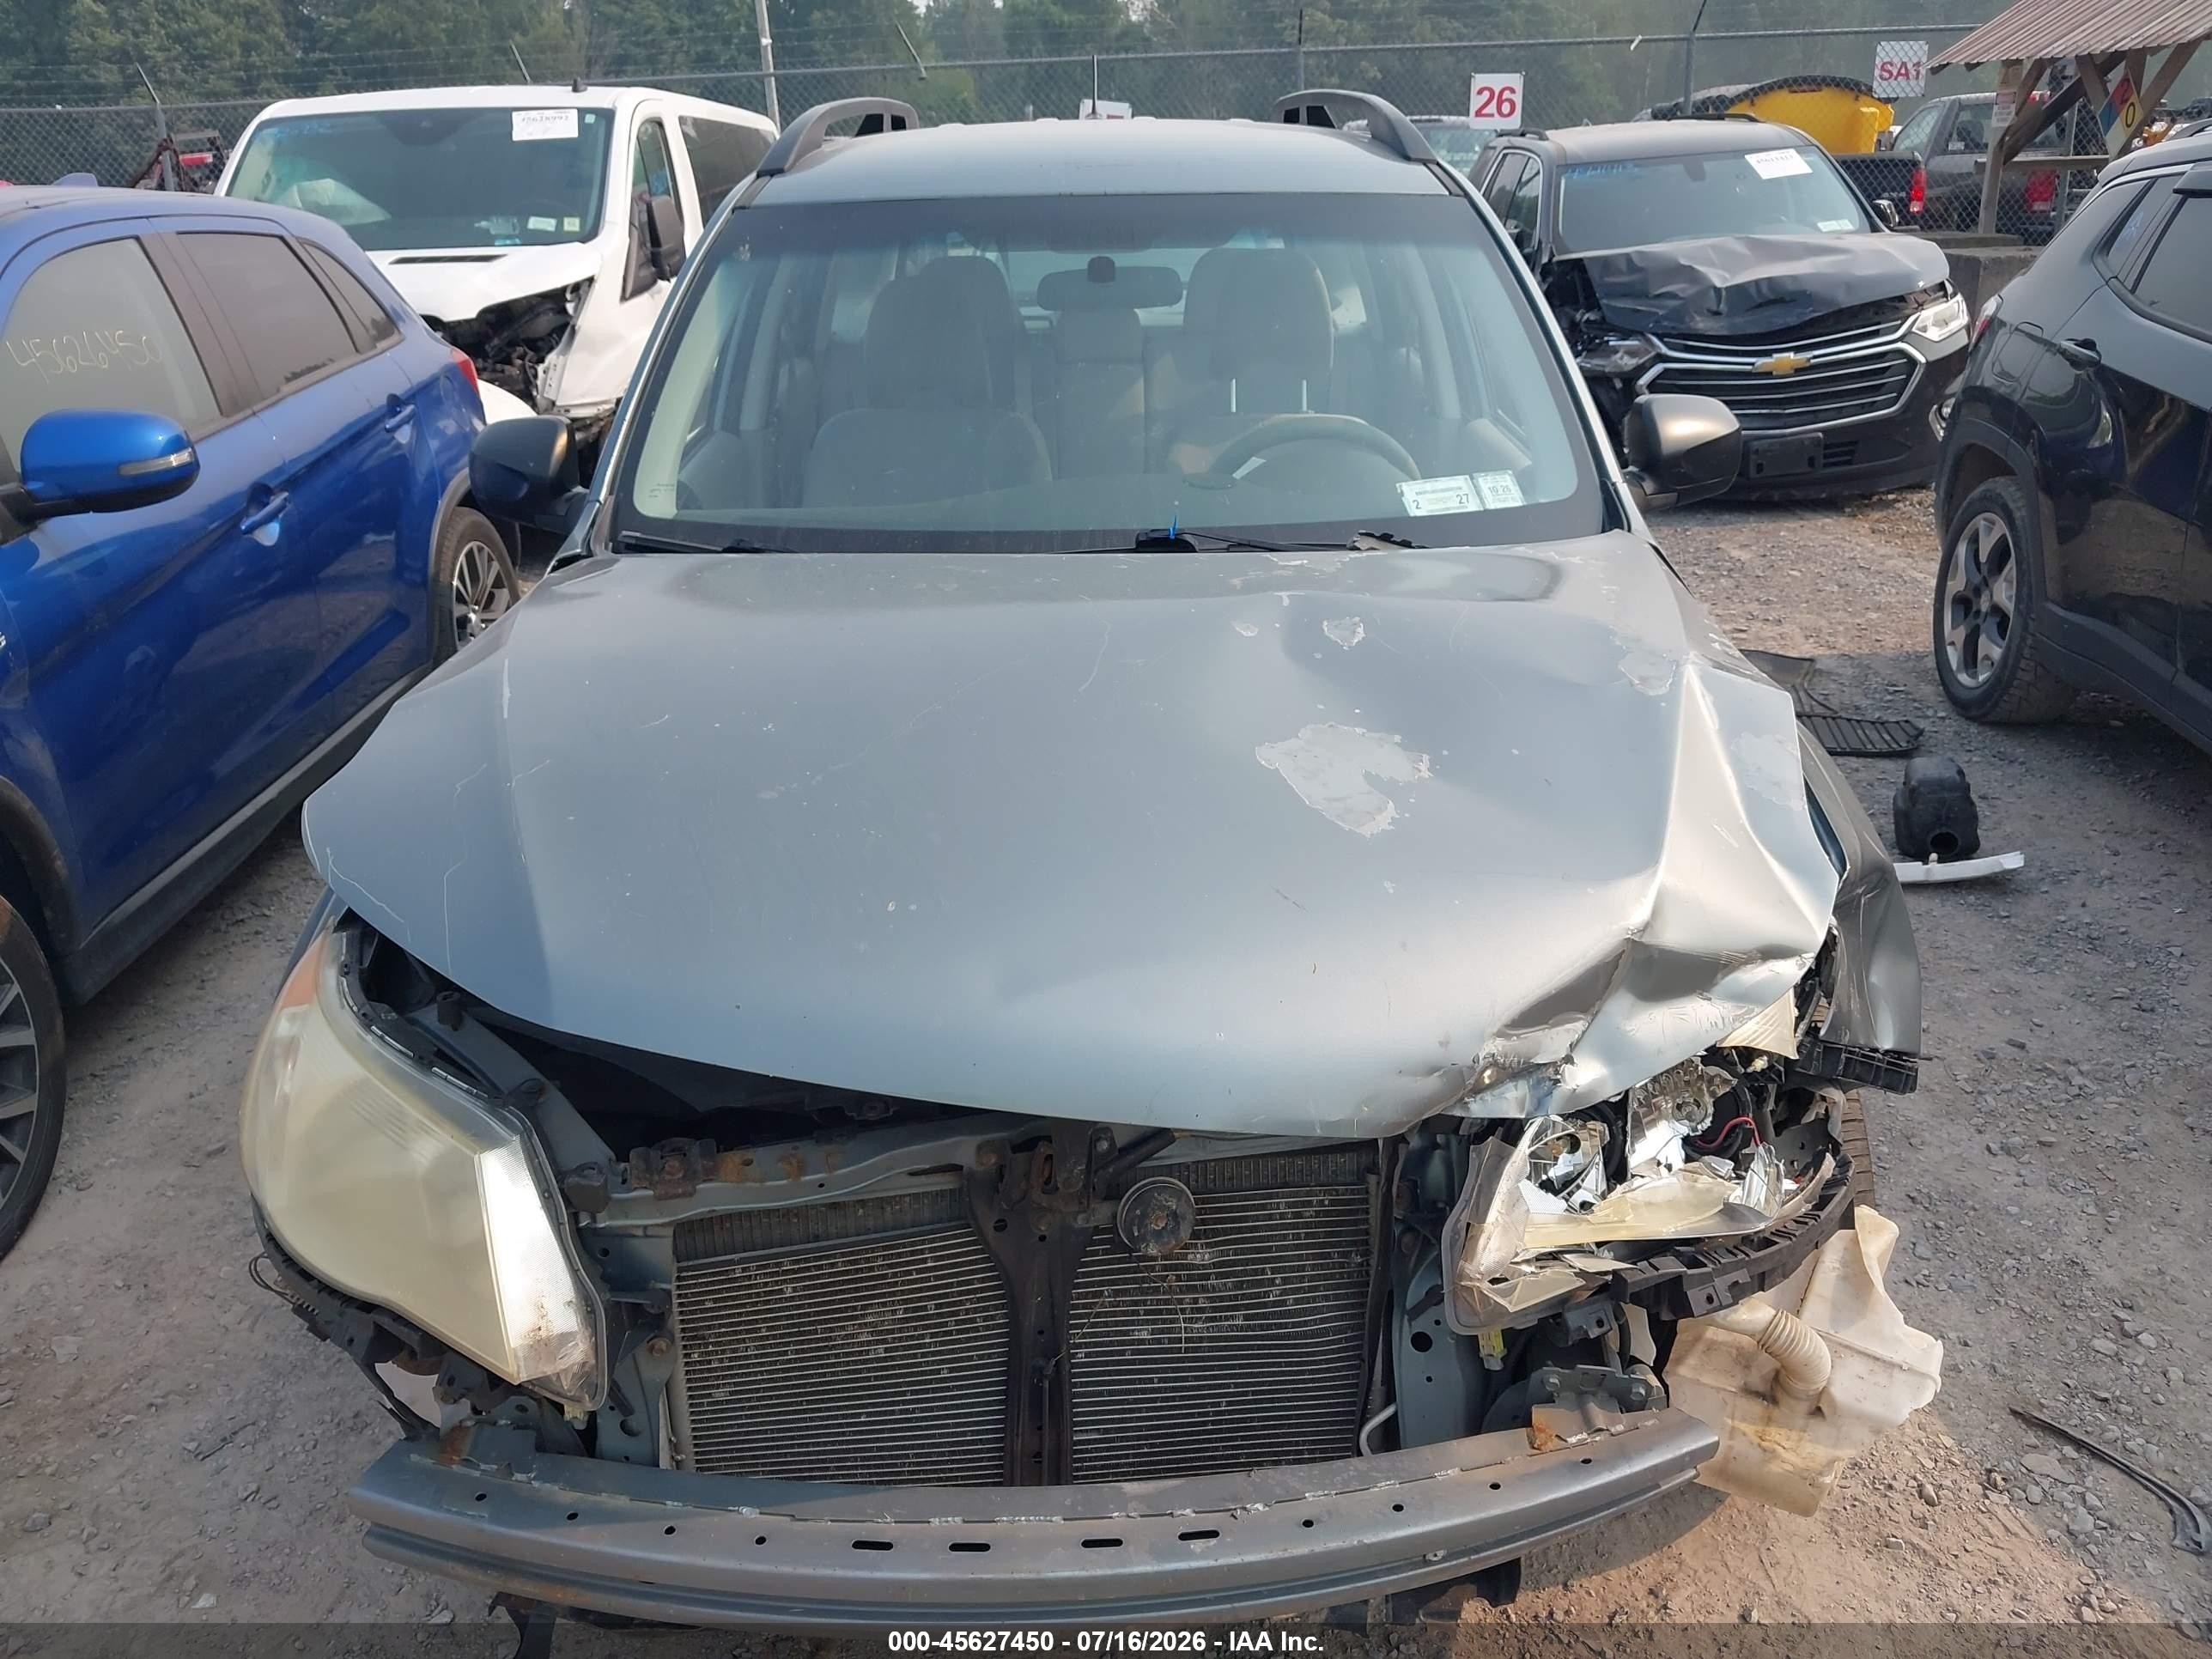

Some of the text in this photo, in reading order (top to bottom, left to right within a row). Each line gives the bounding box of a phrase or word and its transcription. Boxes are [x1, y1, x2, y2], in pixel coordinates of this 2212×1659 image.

[1880, 61, 1922, 81] SA1
[1474, 86, 1516, 118] 26
[2125, 101, 2136, 128] 0
[1413, 500, 1421, 509] 2
[1455, 493, 1470, 505] 27
